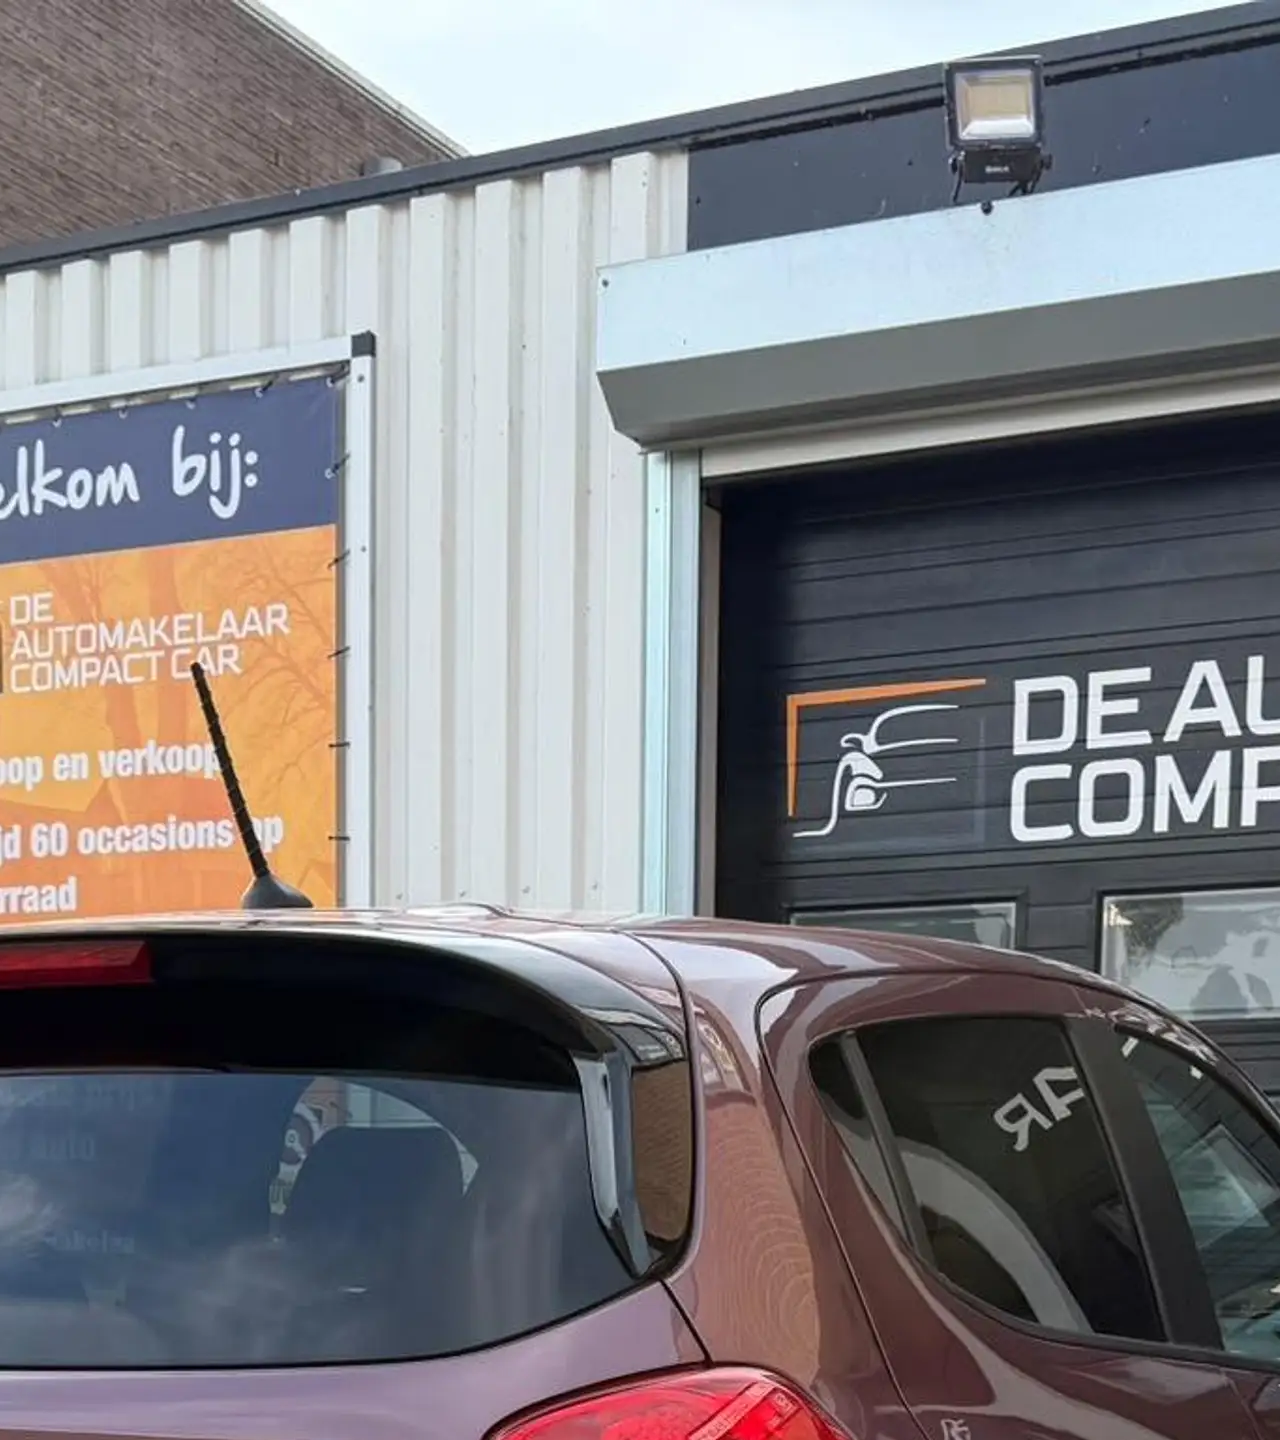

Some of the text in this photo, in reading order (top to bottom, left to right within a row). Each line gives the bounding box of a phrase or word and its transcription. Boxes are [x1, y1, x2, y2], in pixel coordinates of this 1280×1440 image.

[172, 425, 259, 519] bij:
[10, 591, 54, 626] DE
[10, 603, 291, 661] AUTOMAKELAAR
[10, 644, 242, 693] COMPACT CAR
[1011, 667, 1154, 756] DE
[53, 751, 89, 781] en
[31, 821, 68, 858] 60
[78, 816, 234, 855] occasions
